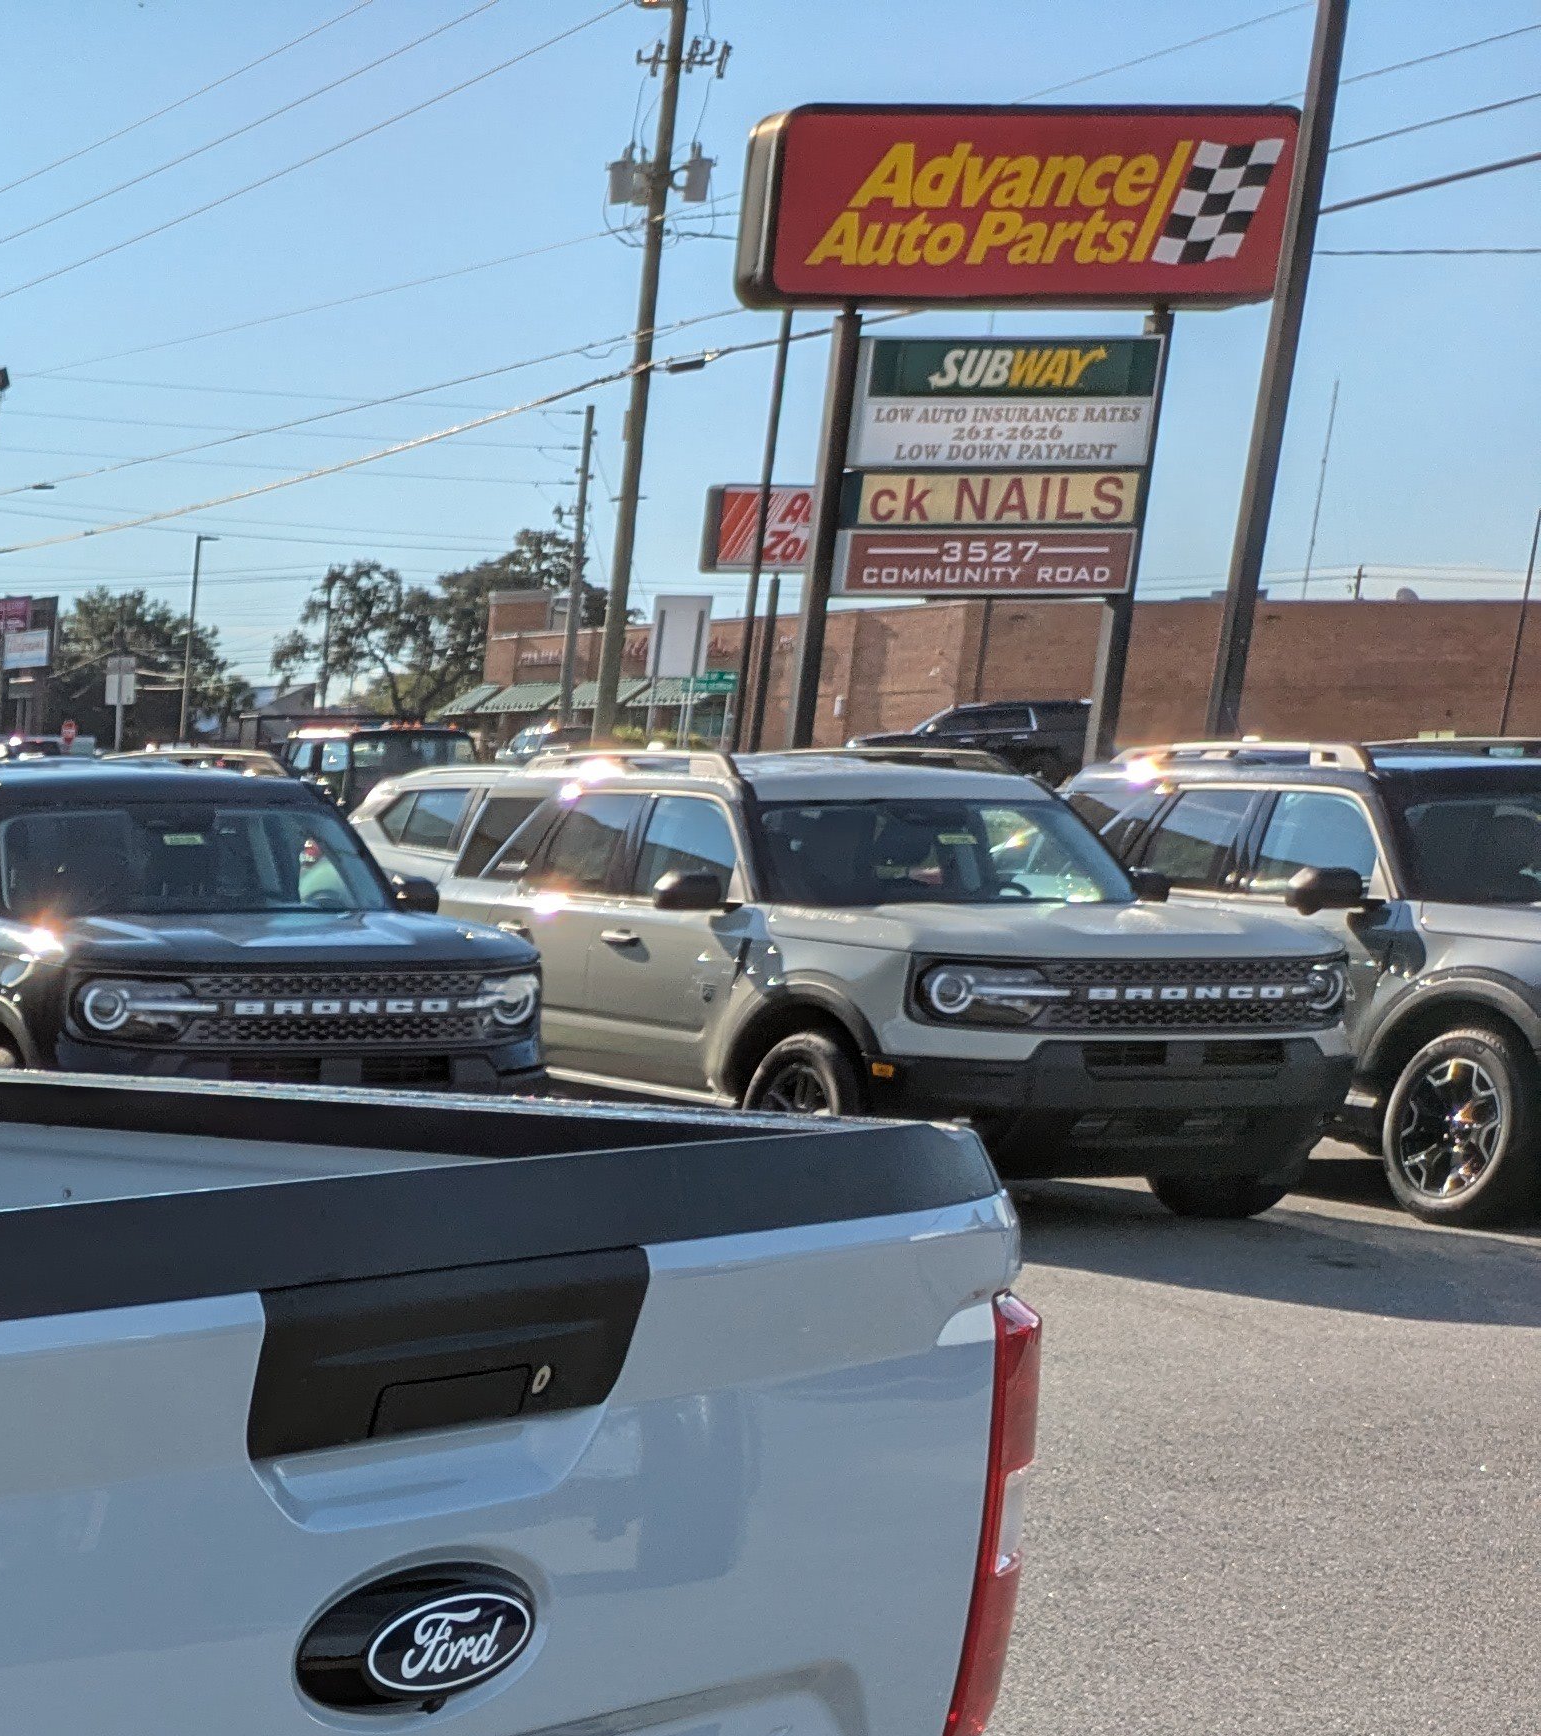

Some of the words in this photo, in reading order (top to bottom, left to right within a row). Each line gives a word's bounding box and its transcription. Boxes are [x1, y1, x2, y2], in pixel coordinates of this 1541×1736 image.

[848, 140, 1161, 208] Advance
[804, 211, 964, 266] Auto
[964, 209, 1136, 265] Parts
[928, 345, 1108, 390] SUBWAY
[874, 407, 915, 424] LOW
[918, 407, 967, 424] AUTO
[973, 406, 1078, 424] INSURANCE
[1081, 405, 1141, 423] RATES
[951, 424, 1063, 442] 261-2626
[894, 444, 942, 461] LOW
[945, 444, 1011, 461] DOWN
[1016, 443, 1118, 461] PAYMENT
[869, 477, 933, 522] ck
[953, 476, 1125, 522] NAILS
[941, 541, 1039, 563] 3527
[862, 565, 1023, 584] COMMUNITY
[1036, 566, 1110, 583] ROAD
[1088, 985, 1285, 1000] BRONCO
[233, 999, 449, 1016] BRONCO
[401, 1606, 504, 1680] Ford
